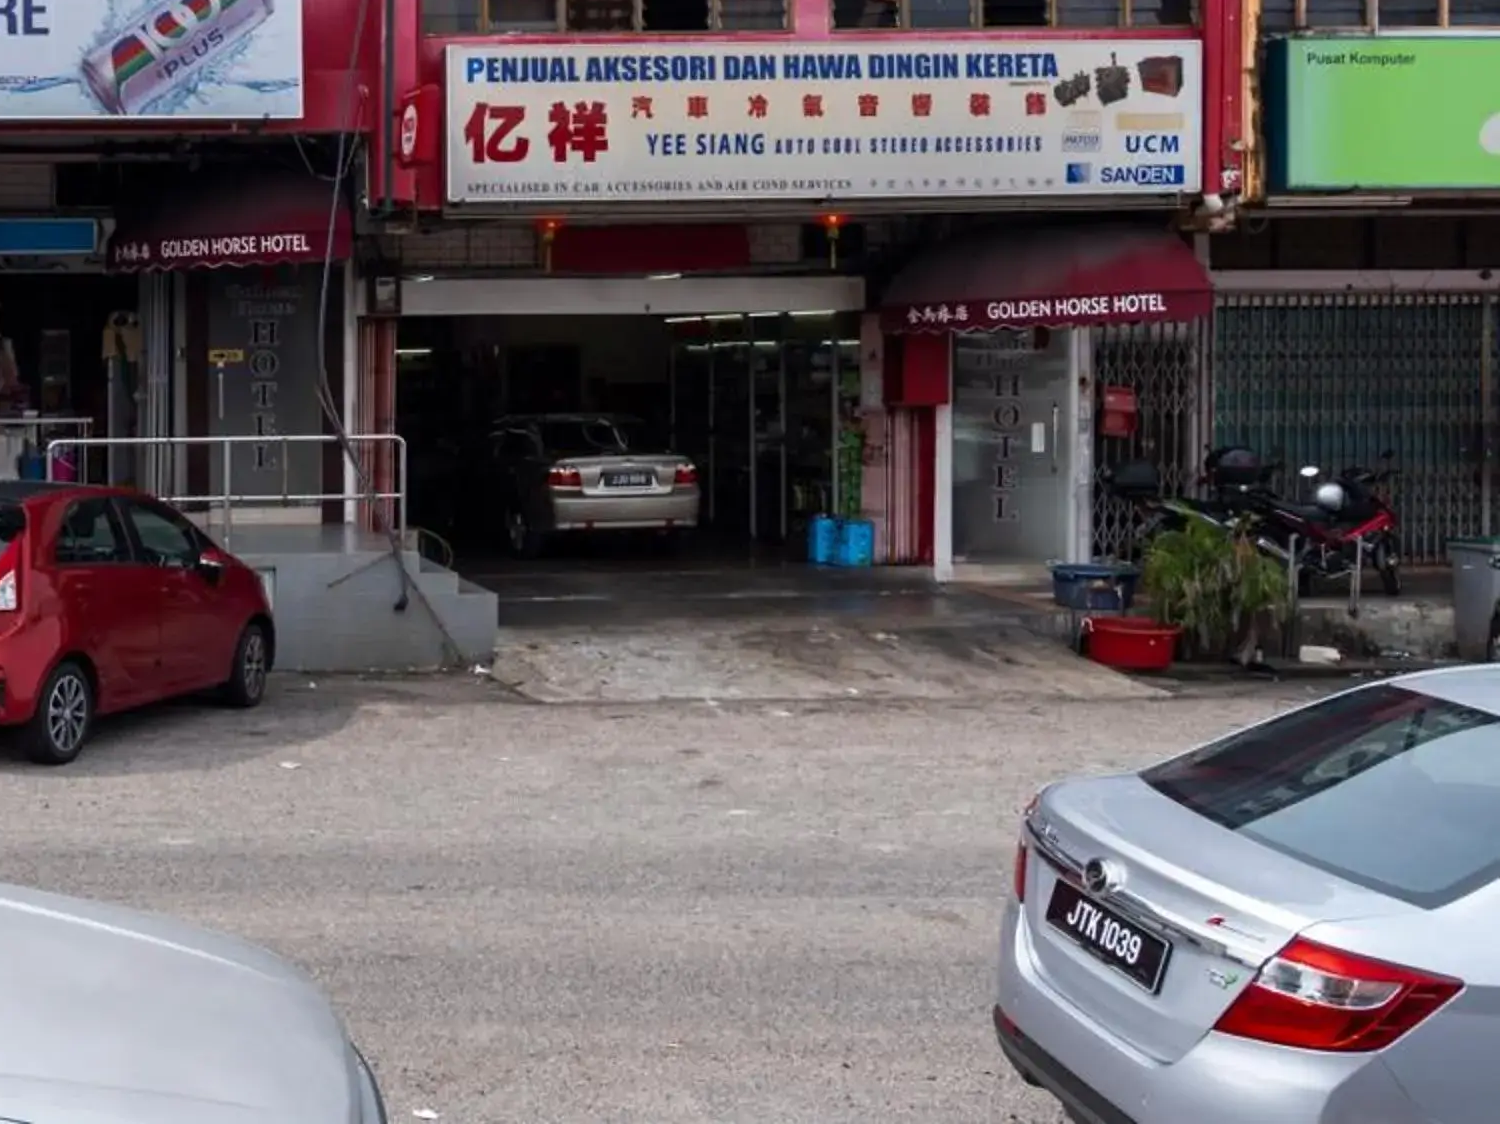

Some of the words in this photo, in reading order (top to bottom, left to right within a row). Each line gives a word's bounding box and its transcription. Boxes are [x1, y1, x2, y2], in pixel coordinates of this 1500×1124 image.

[163, 27, 226, 81] PLUS
[1306, 52, 1346, 66] Pusat
[1349, 52, 1416, 68] Komputer
[466, 56, 580, 83] PENJUAL
[585, 55, 716, 82] AKSESORI
[723, 55, 777, 81] DAN
[783, 53, 862, 81] HAWA
[868, 53, 958, 79] DINGIN
[965, 53, 1059, 79] KERETA
[463, 100, 609, 164] 亿祥
[646, 133, 687, 156] YEE
[695, 133, 766, 156] SIANG
[774, 138, 816, 156] AUTO
[821, 137, 862, 155] COOL
[870, 136, 929, 154] STEREO
[934, 135, 1043, 153] ACCESSORIES
[1124, 134, 1180, 154] UCM
[554, 180, 569, 193] IN
[573, 180, 601, 193] CAR
[606, 180, 693, 193] ACCESSORIES
[697, 180, 724, 192] AND
[726, 179, 749, 192] AIR
[752, 179, 788, 191] COND
[791, 178, 852, 191] SERVICES
[1100, 166, 1176, 184] SANDEN
[160, 238, 209, 258] GOLDEN
[211, 235, 257, 256] HORSE
[260, 233, 311, 253] HOTEL
[987, 300, 1051, 321] GOLDEN
[1055, 297, 1109, 317] HORSE
[1113, 293, 1167, 314] HOTEL
[248, 318, 281, 472] HOTEL
[992, 373, 1023, 524] HOTEL
